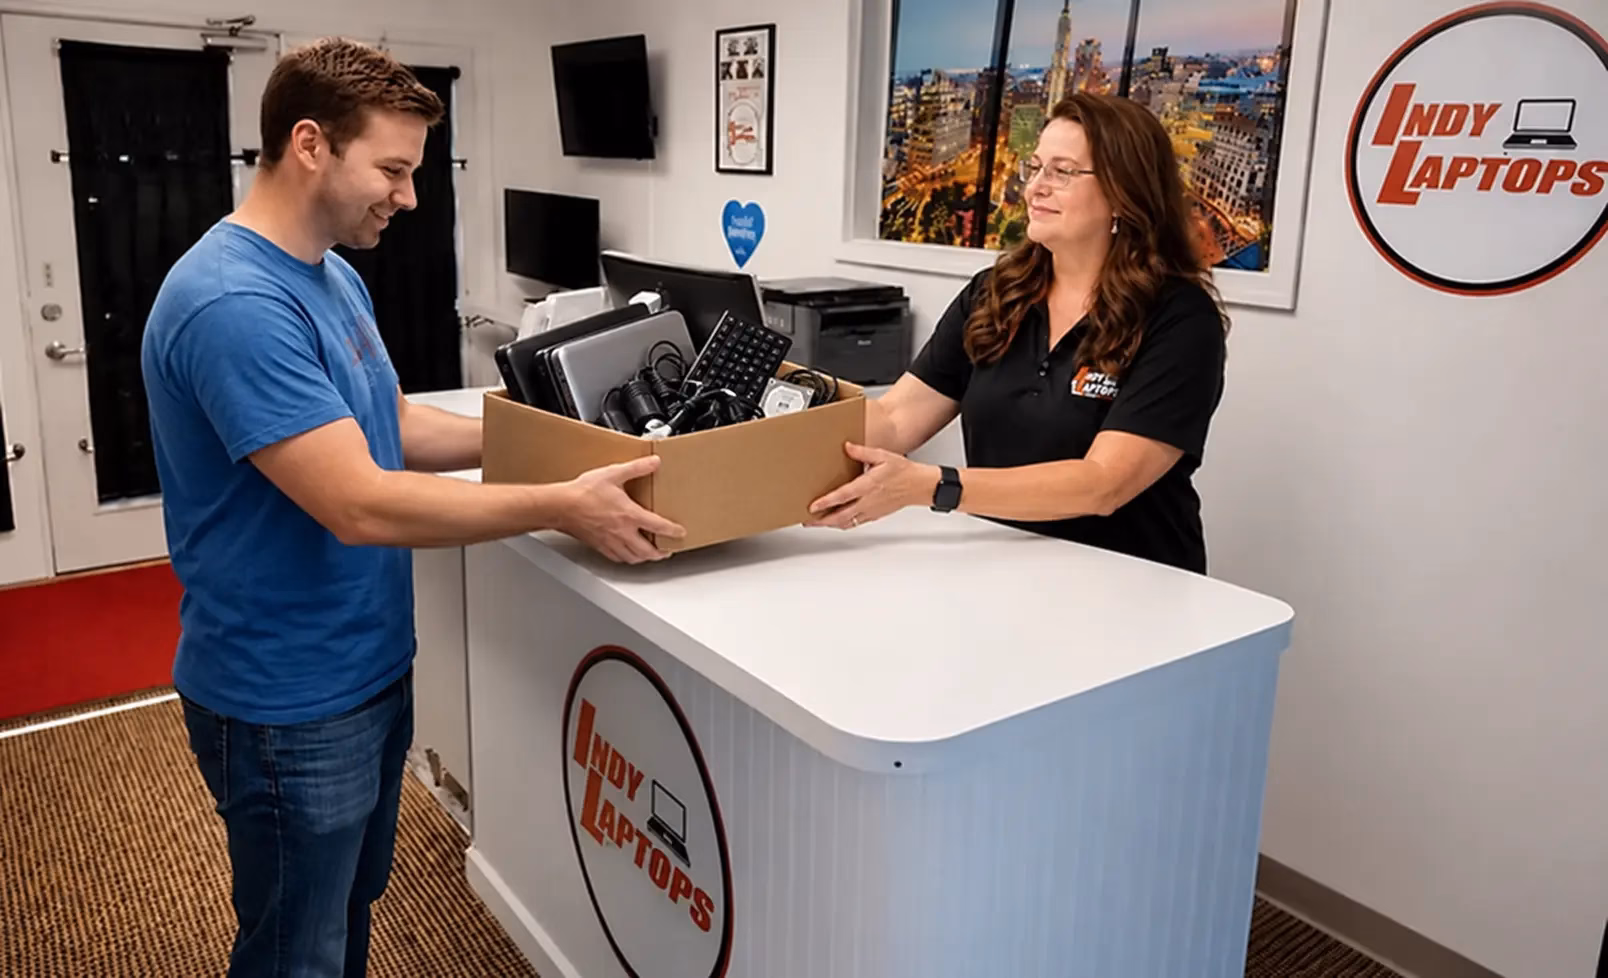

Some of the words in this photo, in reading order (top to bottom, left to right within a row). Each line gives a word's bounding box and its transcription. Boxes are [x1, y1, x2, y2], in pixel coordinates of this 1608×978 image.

[1371, 83, 1502, 146] INDY
[1376, 140, 1608, 205] LAPTOPS
[573, 698, 645, 802] INDY
[580, 766, 715, 932] LAPTOPS
